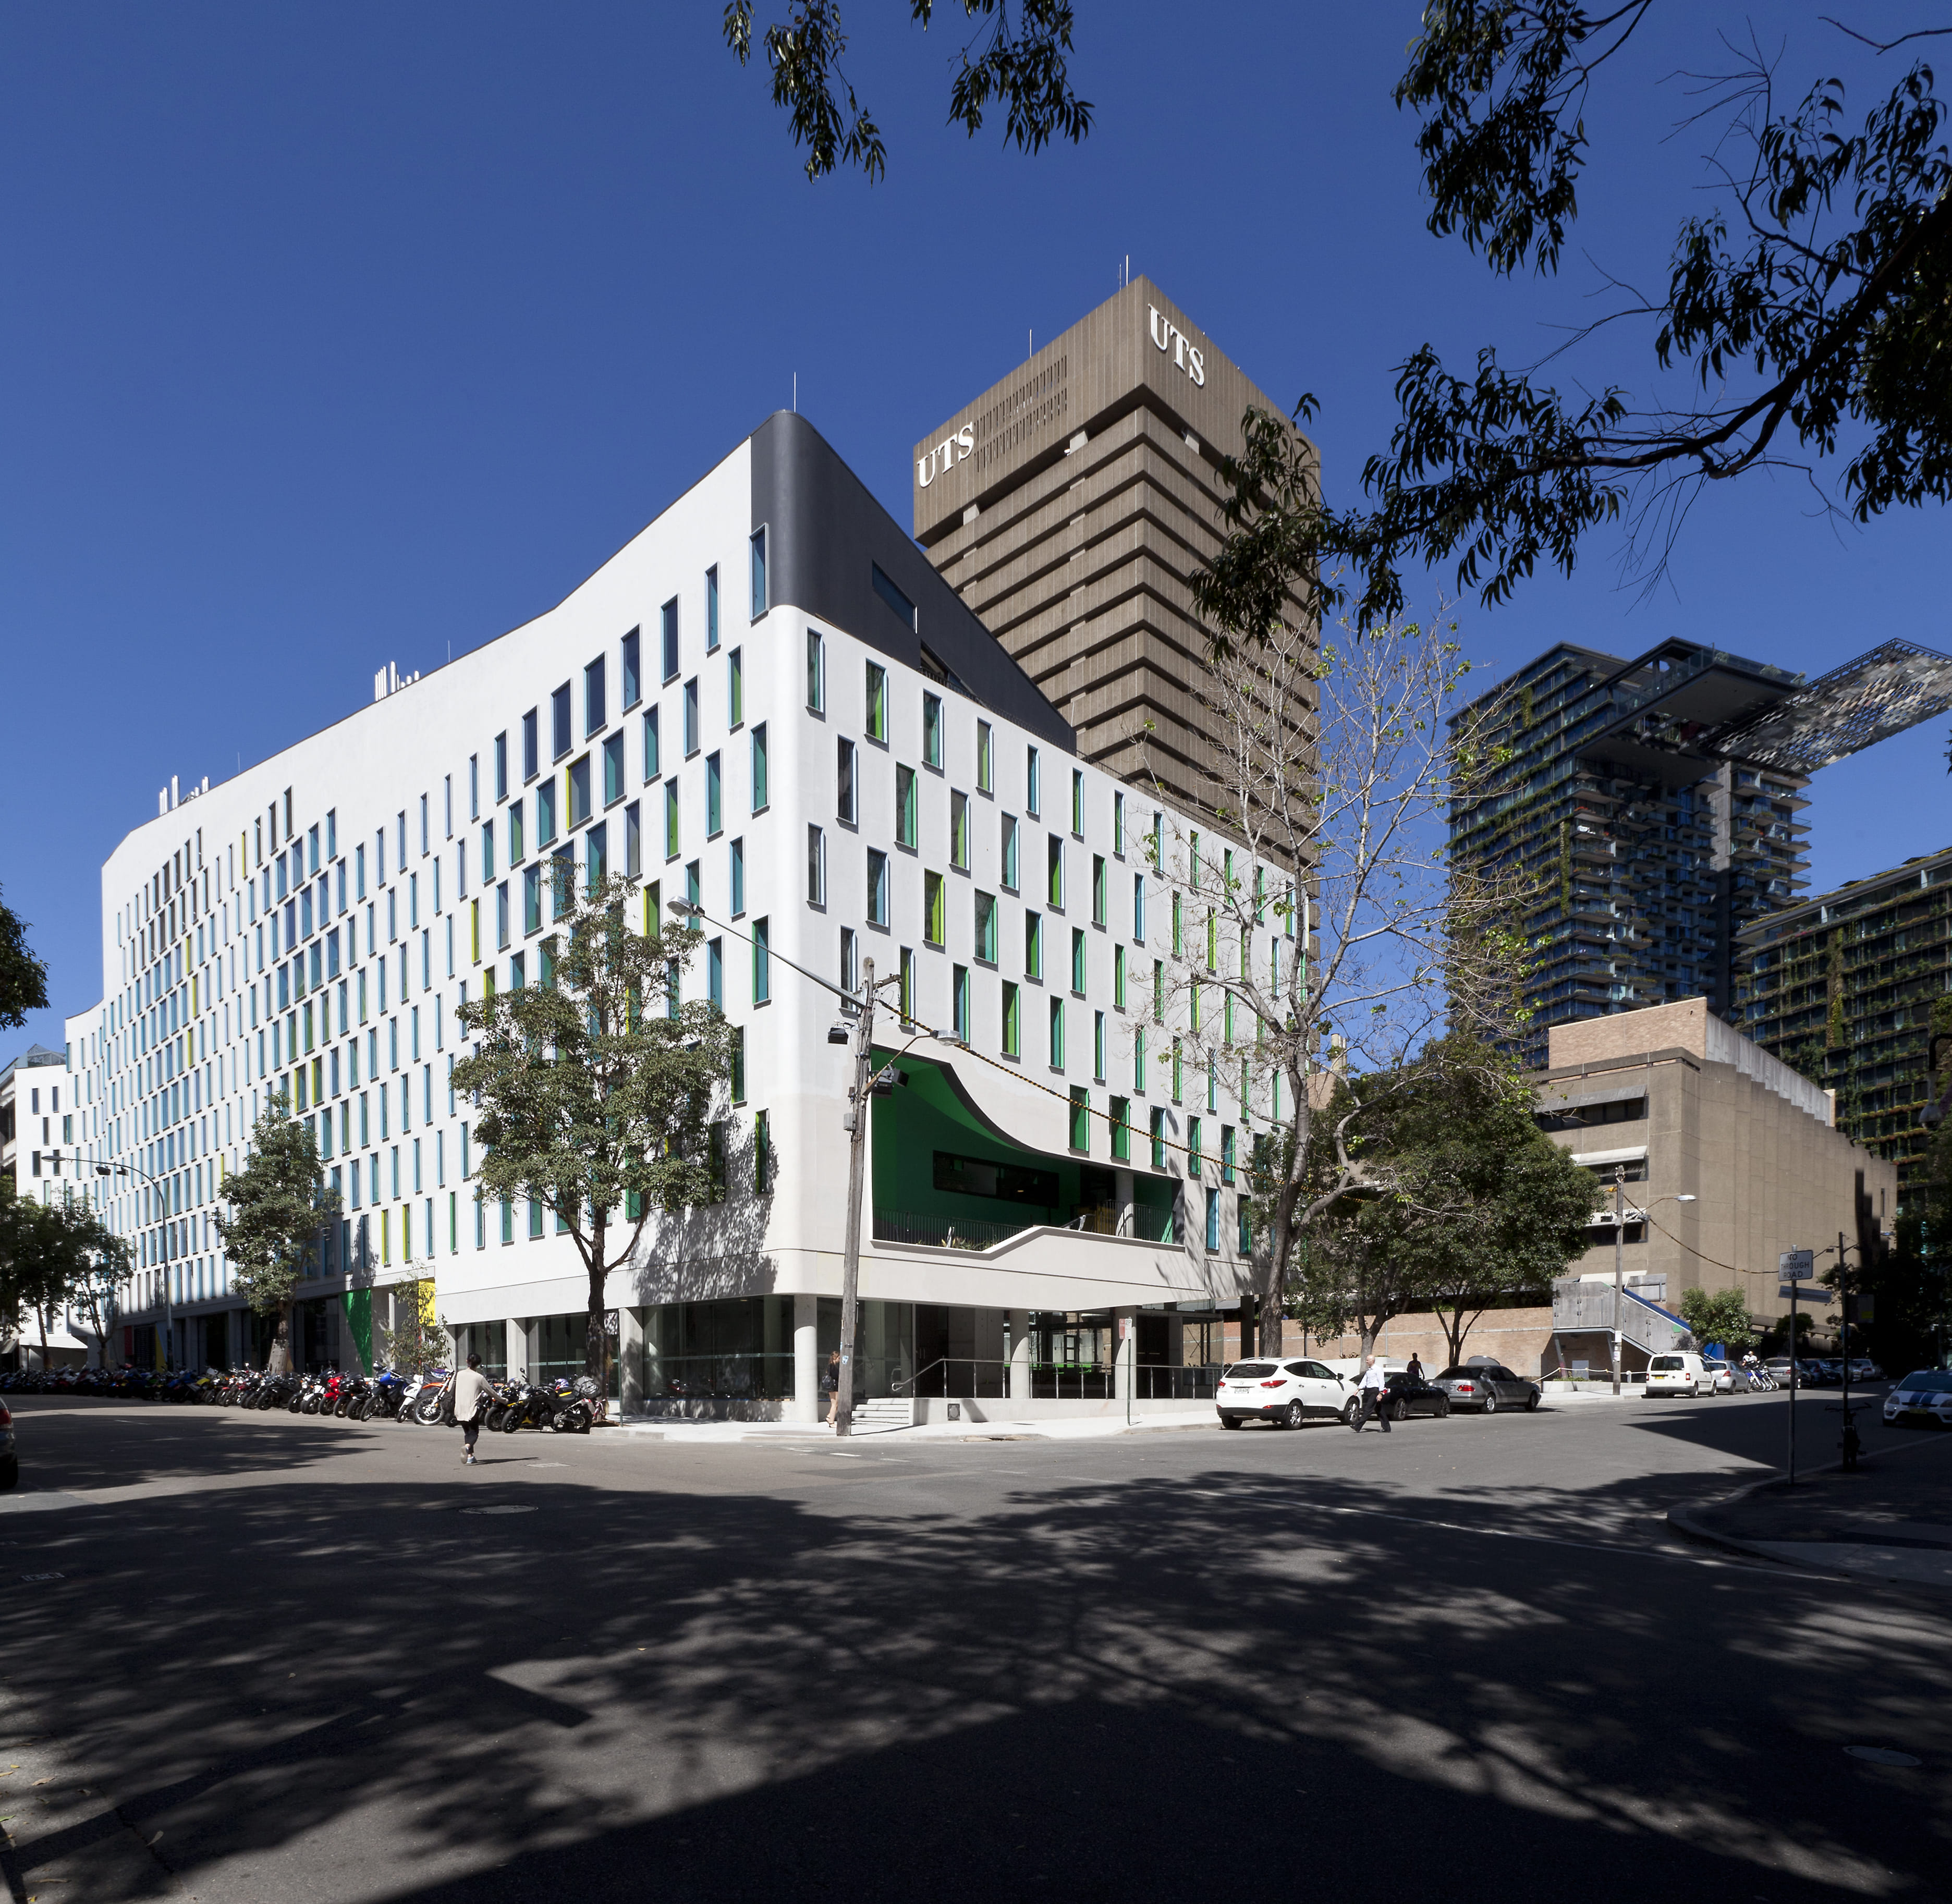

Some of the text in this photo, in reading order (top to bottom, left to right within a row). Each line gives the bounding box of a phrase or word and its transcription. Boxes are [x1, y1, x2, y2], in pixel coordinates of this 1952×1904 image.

[1148, 303, 1205, 386] UTS
[917, 421, 974, 488] UTS
[1781, 1262, 1810, 1270] THROUGH
